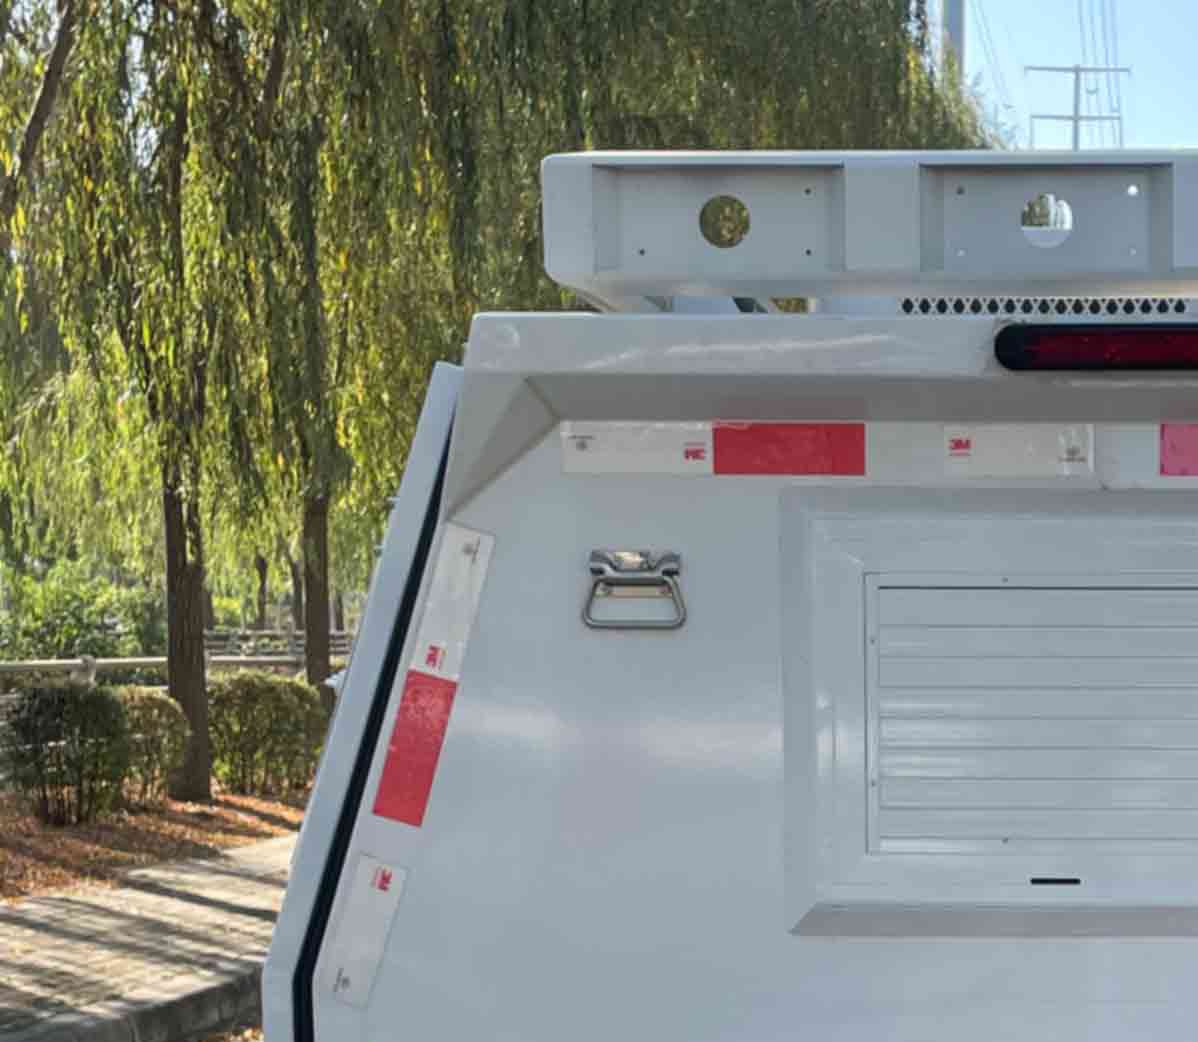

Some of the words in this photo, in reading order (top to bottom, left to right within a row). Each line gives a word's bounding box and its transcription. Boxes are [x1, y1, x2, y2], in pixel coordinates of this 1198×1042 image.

[949, 438, 971, 450] 3M
[684, 447, 705, 460] 3M
[425, 645, 441, 667] 3M
[375, 868, 393, 891] 3M
